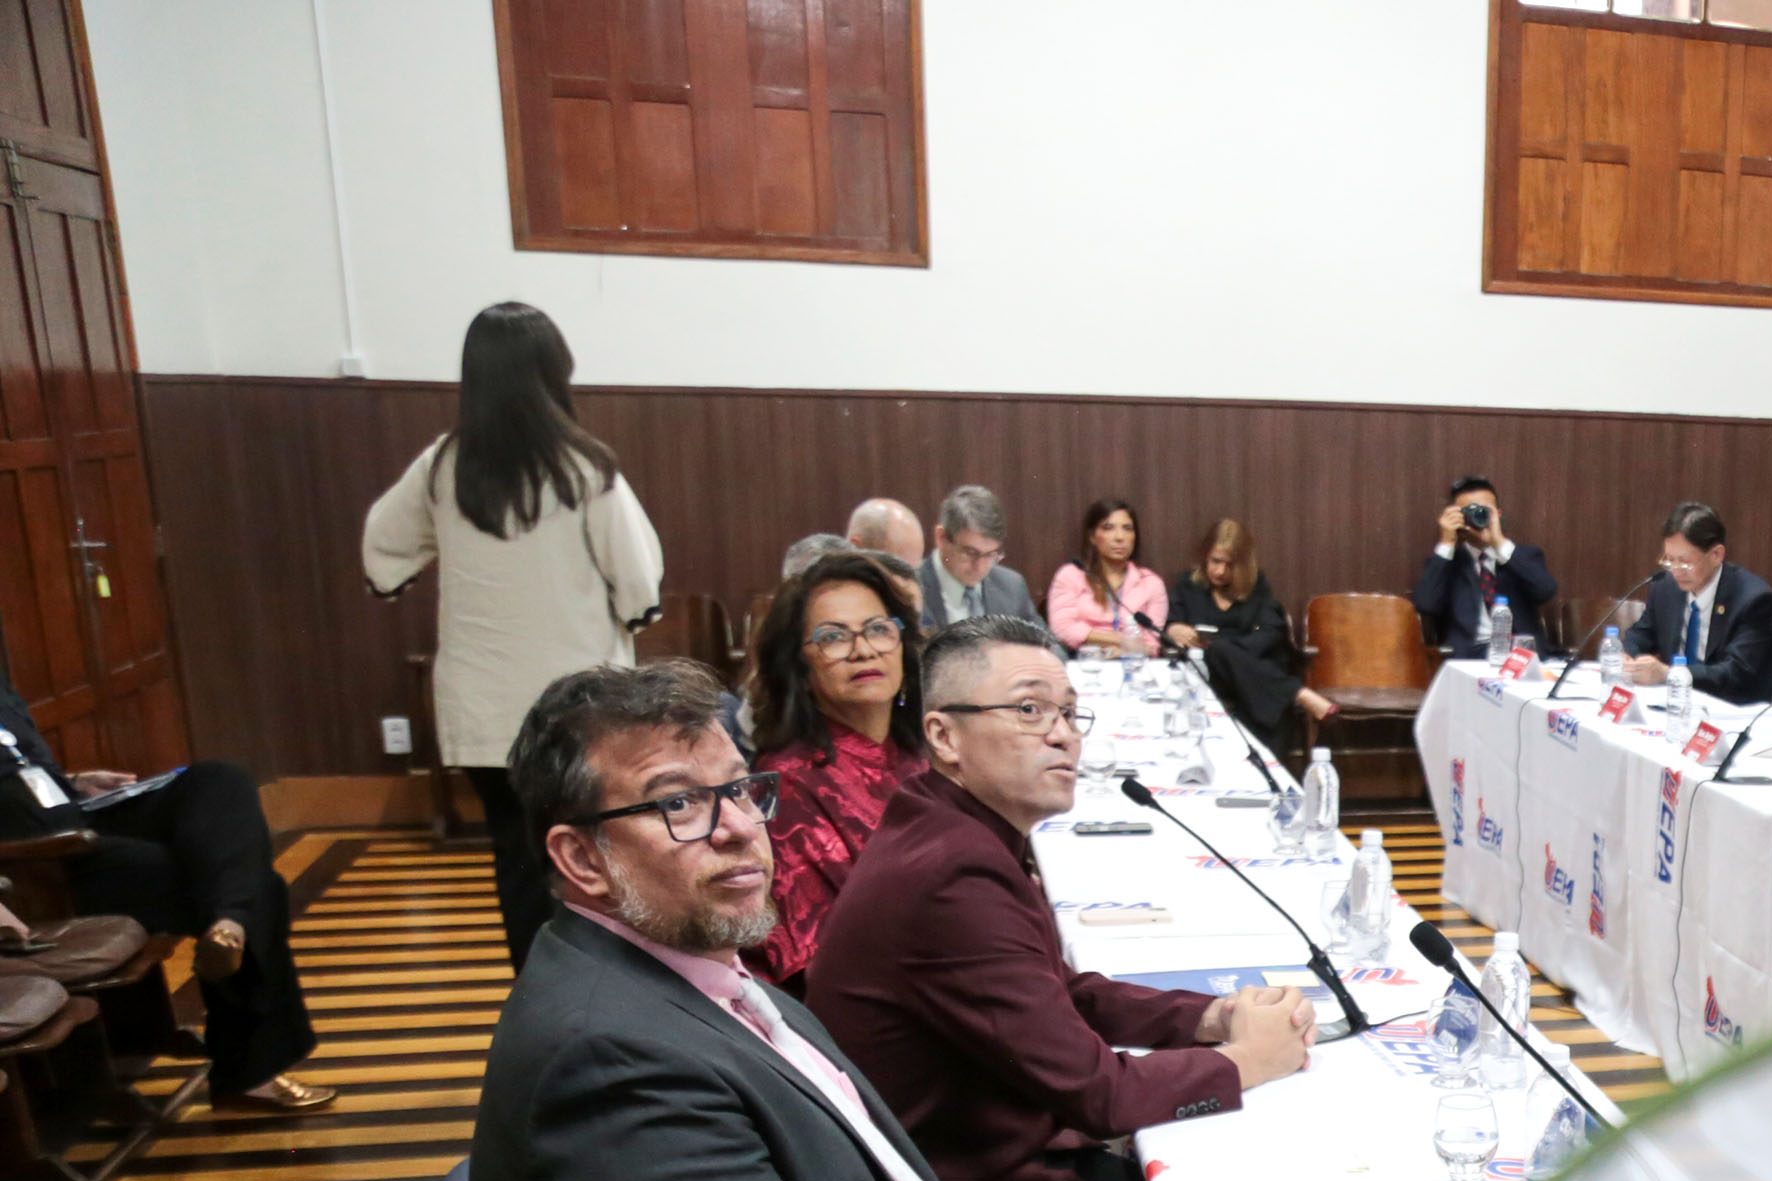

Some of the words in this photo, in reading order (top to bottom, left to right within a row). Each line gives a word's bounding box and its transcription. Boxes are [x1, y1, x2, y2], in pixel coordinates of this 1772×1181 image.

[1547, 708, 1579, 743] UEPA
[1659, 766, 1682, 884] UEPA
[1187, 856, 1344, 869] UEPA
